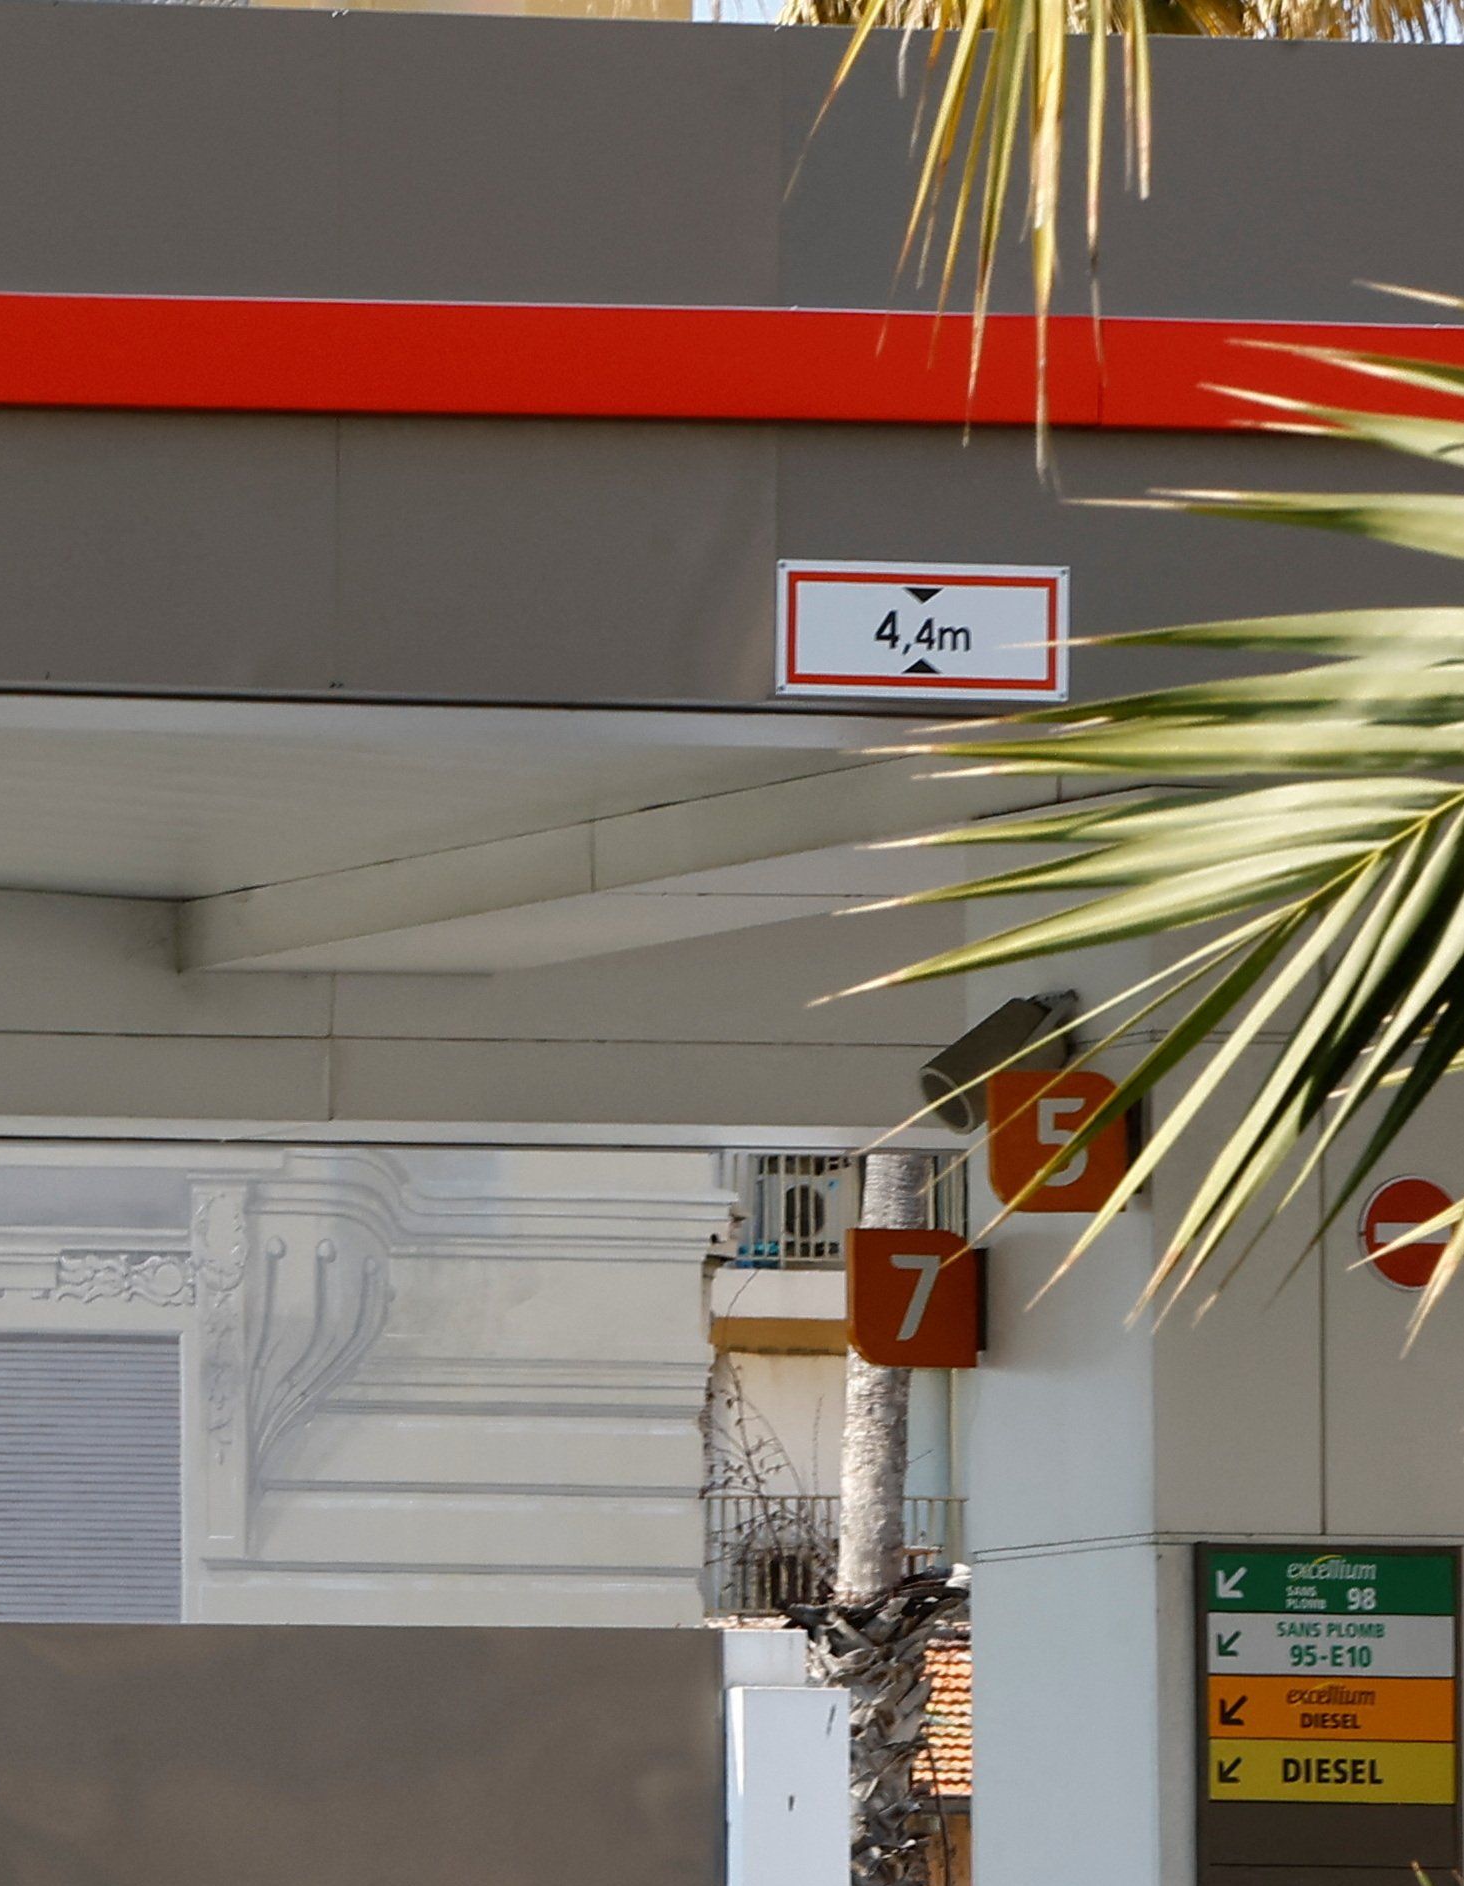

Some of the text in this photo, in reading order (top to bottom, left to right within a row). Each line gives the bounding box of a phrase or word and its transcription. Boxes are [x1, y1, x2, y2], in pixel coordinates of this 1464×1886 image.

[874, 609, 971, 655] 4,4m
[1035, 1097, 1087, 1188] 5
[890, 1254, 941, 1342] 7
[1286, 1559, 1377, 1582] excellium
[1347, 1588, 1377, 1611] 98
[1277, 1621, 1385, 1639] SANS PLOMB
[1290, 1645, 1372, 1668] 95-E10
[1287, 1685, 1376, 1706] excellium
[1300, 1713, 1361, 1730] DIESEL
[1282, 1758, 1383, 1785] DIESEL
